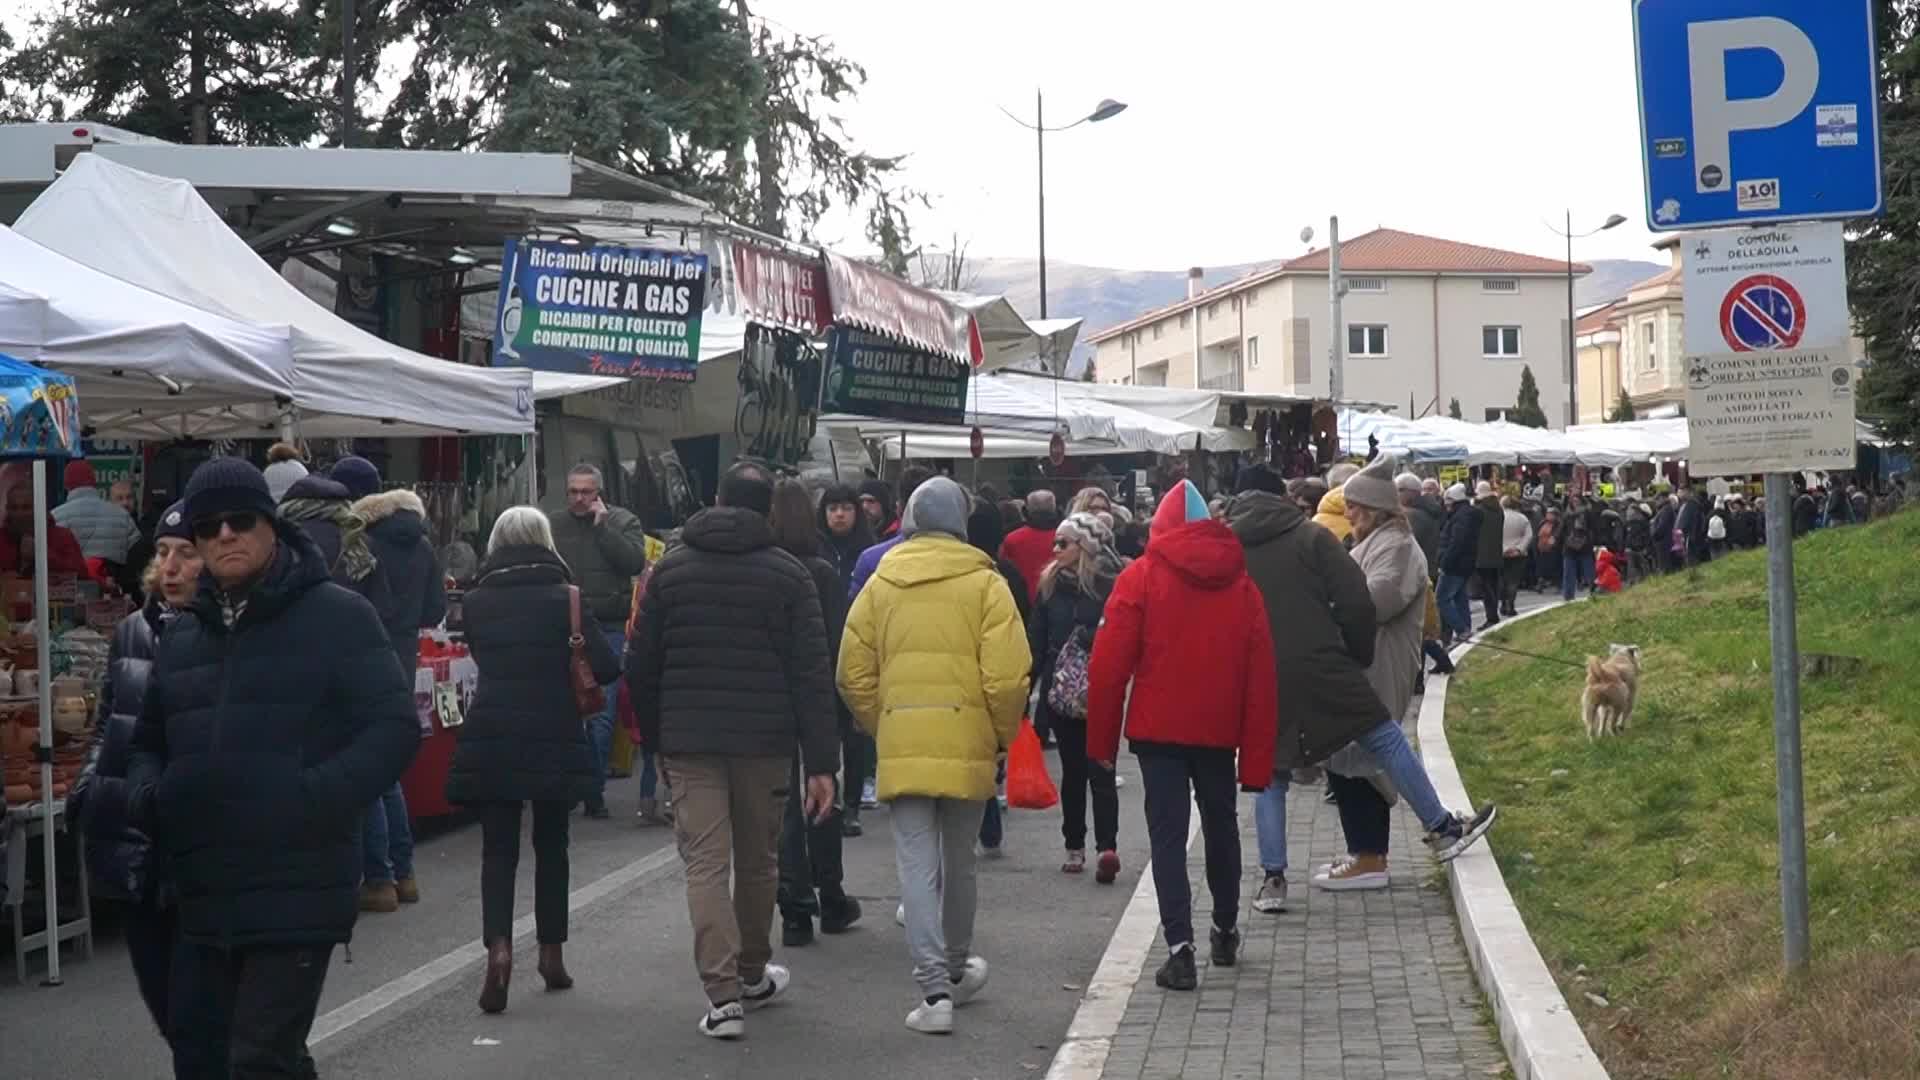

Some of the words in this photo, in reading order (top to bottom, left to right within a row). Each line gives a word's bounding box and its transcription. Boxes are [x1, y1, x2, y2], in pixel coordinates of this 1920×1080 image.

[1688, 16, 1820, 193] P
[530, 247, 596, 272] Ricambi
[600, 255, 670, 278] Originali
[673, 261, 703, 281] per
[536, 275, 618, 308] CUCINE
[623, 282, 638, 310] A
[645, 284, 690, 315] GAS
[539, 311, 597, 330] RICAMBI
[599, 315, 624, 332] PER
[626, 318, 687, 337] FOLLETTO
[532, 330, 616, 352] COMPATIBILI
[618, 337, 632, 353] DI
[636, 339, 689, 358] QUALITÀ
[853, 350, 911, 373] CUCINE
[914, 355, 924, 375] A
[929, 357, 959, 377] GAS
[1711, 360, 1756, 369] COMUNE
[1761, 358, 1772, 367] DI
[1707, 392, 1752, 402] DIVIETO
[1755, 391, 1765, 399] DI
[1768, 389, 1803, 398] SOSTA
[1725, 404, 1756, 413] AMBO
[1691, 418, 1713, 427] CON
[1716, 415, 1777, 425] RIMOZIONE
[1781, 411, 1833, 421] FORZATA
